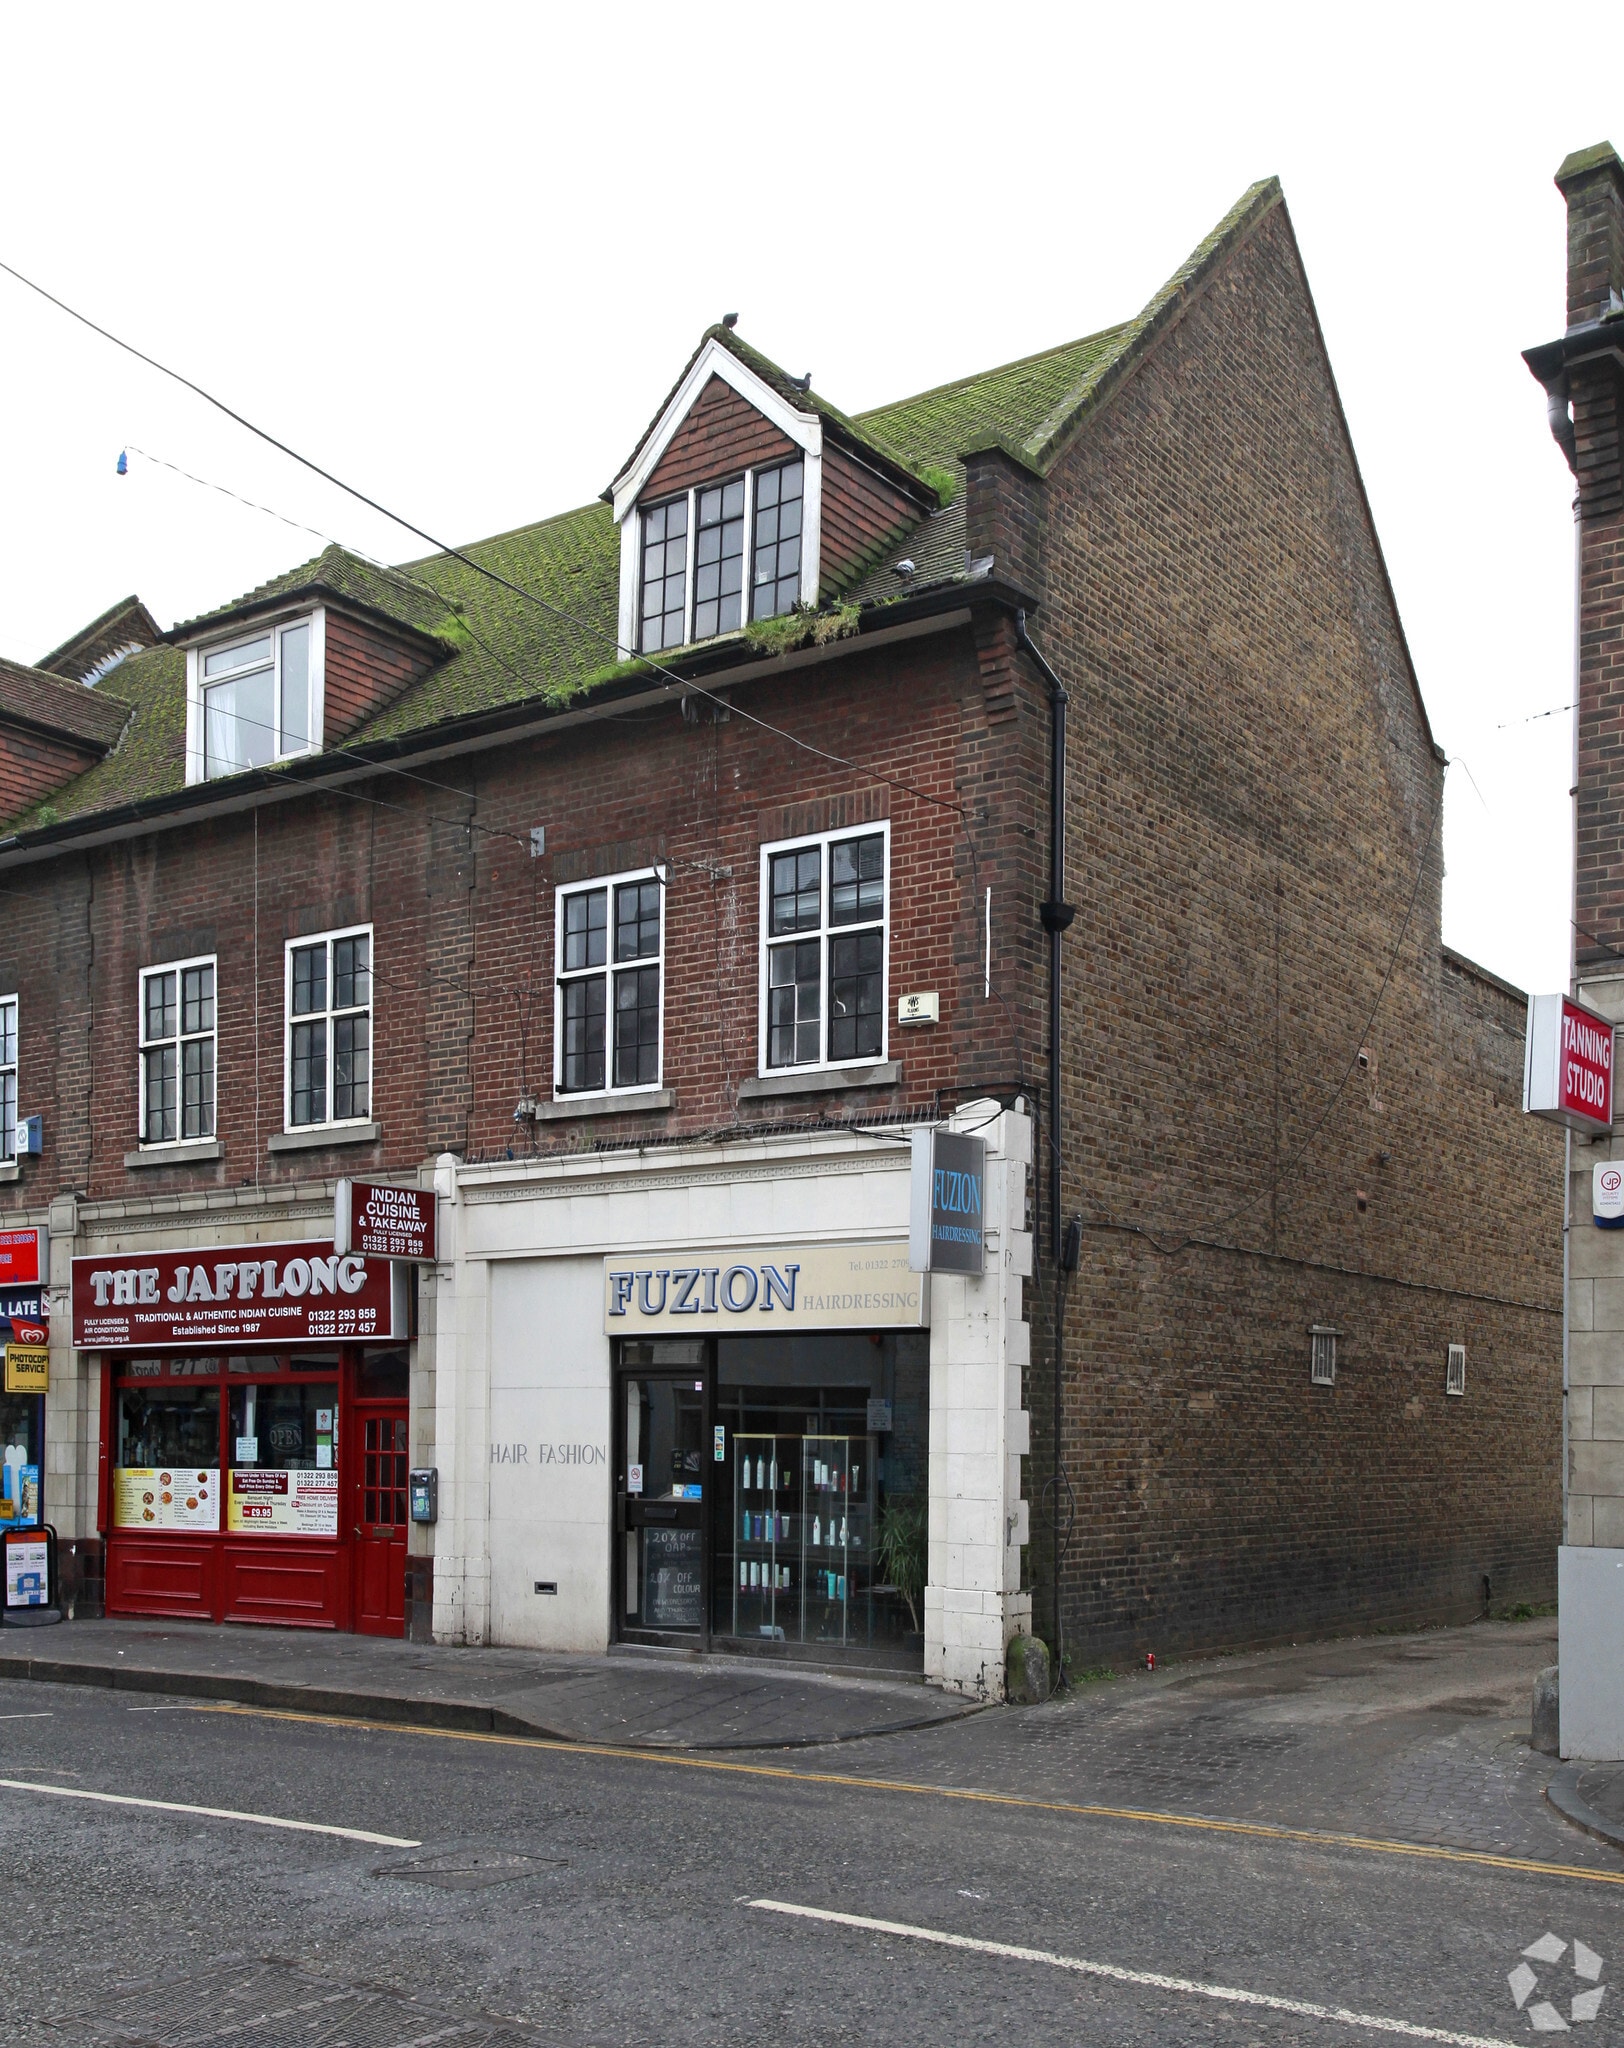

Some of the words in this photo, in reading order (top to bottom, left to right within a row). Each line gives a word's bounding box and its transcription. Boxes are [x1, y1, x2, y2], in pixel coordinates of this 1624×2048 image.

[1563, 1015, 1610, 1070] TANNING
[1566, 1061, 1605, 1109] STUDIO
[371, 1188, 416, 1205] INDIAN
[933, 1169, 981, 1215] FUZION
[366, 1202, 420, 1219] CUISINE
[358, 1215, 366, 1226] &
[369, 1216, 427, 1232] TAKEAWAY
[363, 1235, 387, 1244] 01322
[390, 1237, 405, 1246] 293
[407, 1239, 423, 1247] 858
[388, 1230, 412, 1238] LICENSED
[932, 1225, 982, 1245] HAIRDRESSING
[363, 1243, 388, 1251] 01322
[390, 1245, 405, 1253] 277
[408, 1247, 423, 1255] 457
[866, 1260, 888, 1270] 01322
[90, 1268, 160, 1306] THE
[168, 1255, 367, 1303] JAFFLONG
[609, 1264, 801, 1315] FUZION
[8, 1300, 38, 1316] LATE
[803, 1292, 919, 1310] HAIRDRESSING
[135, 1313, 184, 1323] TRADITIONAL
[186, 1312, 192, 1321] &
[193, 1310, 237, 1321] AUTHENTIC
[239, 1308, 267, 1319] INDIAN
[268, 1307, 303, 1317] CUISINE
[308, 1311, 336, 1321] 01322
[338, 1309, 356, 1320] 293
[358, 1308, 377, 1318] 858
[84, 1318, 98, 1326] FULLY
[308, 1324, 336, 1335] 01322
[338, 1324, 356, 1333] 277
[358, 1322, 377, 1332] 457
[173, 1325, 216, 1336] Established
[218, 1325, 240, 1334] Since
[242, 1323, 260, 1333] 1987
[16, 1363, 45, 1373] SERVICE
[490, 1443, 529, 1464] HAIR
[539, 1444, 606, 1465] FASHION
[252, 1507, 271, 1518] £9.95
[680, 1532, 696, 1542] OFF
[677, 1572, 693, 1583] OFF
[673, 1584, 701, 1594] COLOUR
